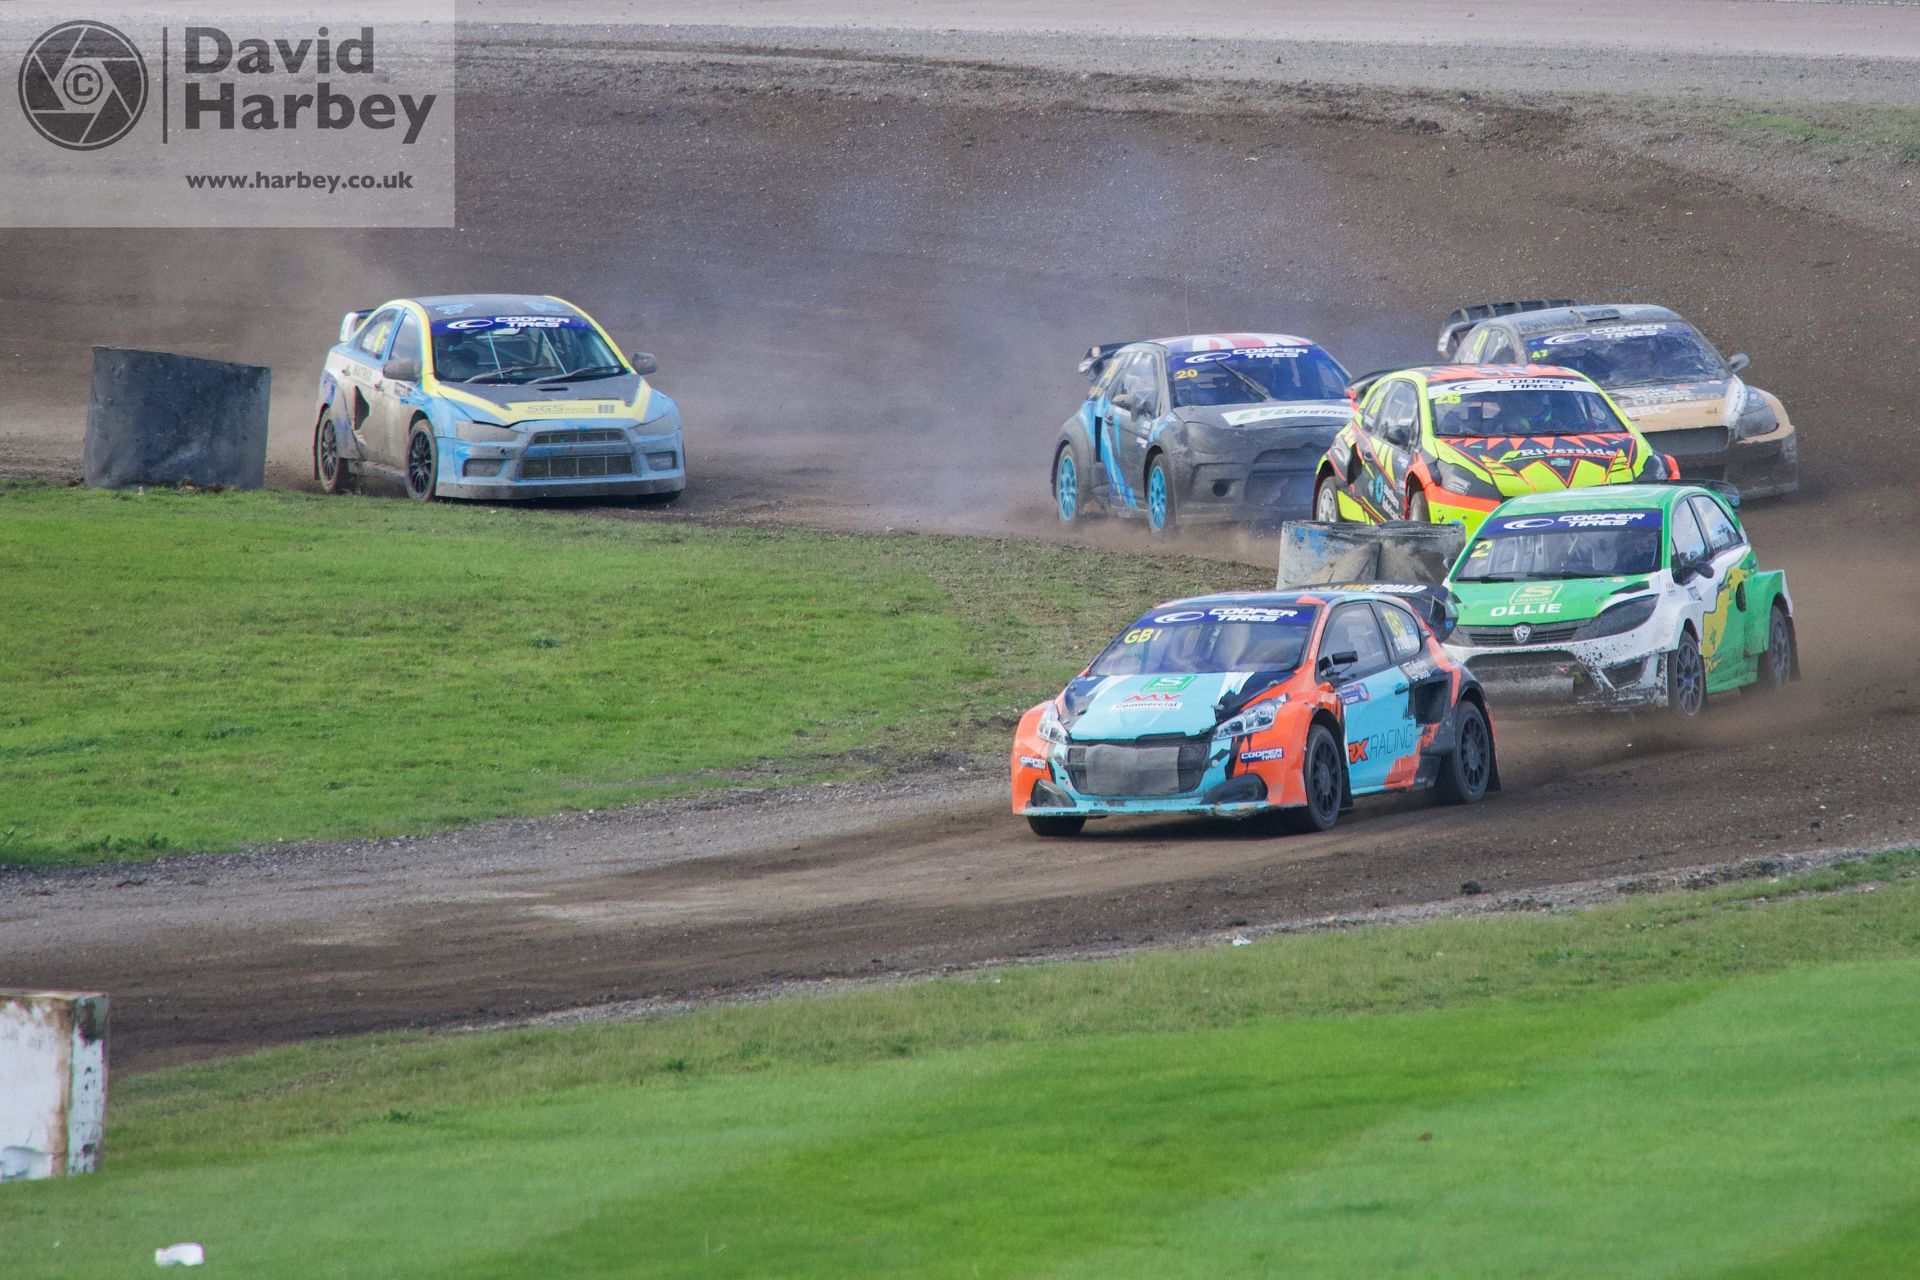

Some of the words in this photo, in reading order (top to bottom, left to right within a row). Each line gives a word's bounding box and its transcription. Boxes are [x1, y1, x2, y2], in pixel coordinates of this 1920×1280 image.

[495, 316, 570, 324] COOPER
[1591, 325, 1667, 335] COOPER
[1604, 331, 1657, 339] TIRES
[1233, 347, 1308, 355] COOPER
[1531, 350, 1548, 359] 47
[1176, 369, 1199, 380] 20
[1434, 394, 1461, 405] 26
[1520, 448, 1617, 457] Riverside
[1558, 513, 1646, 523] COOPER
[1471, 541, 1493, 558] 2
[1209, 607, 1298, 617] COOPER
[1490, 604, 1563, 617] OLLIE
[1369, 723, 1414, 759] RACING
[1241, 748, 1283, 760] COOPER
